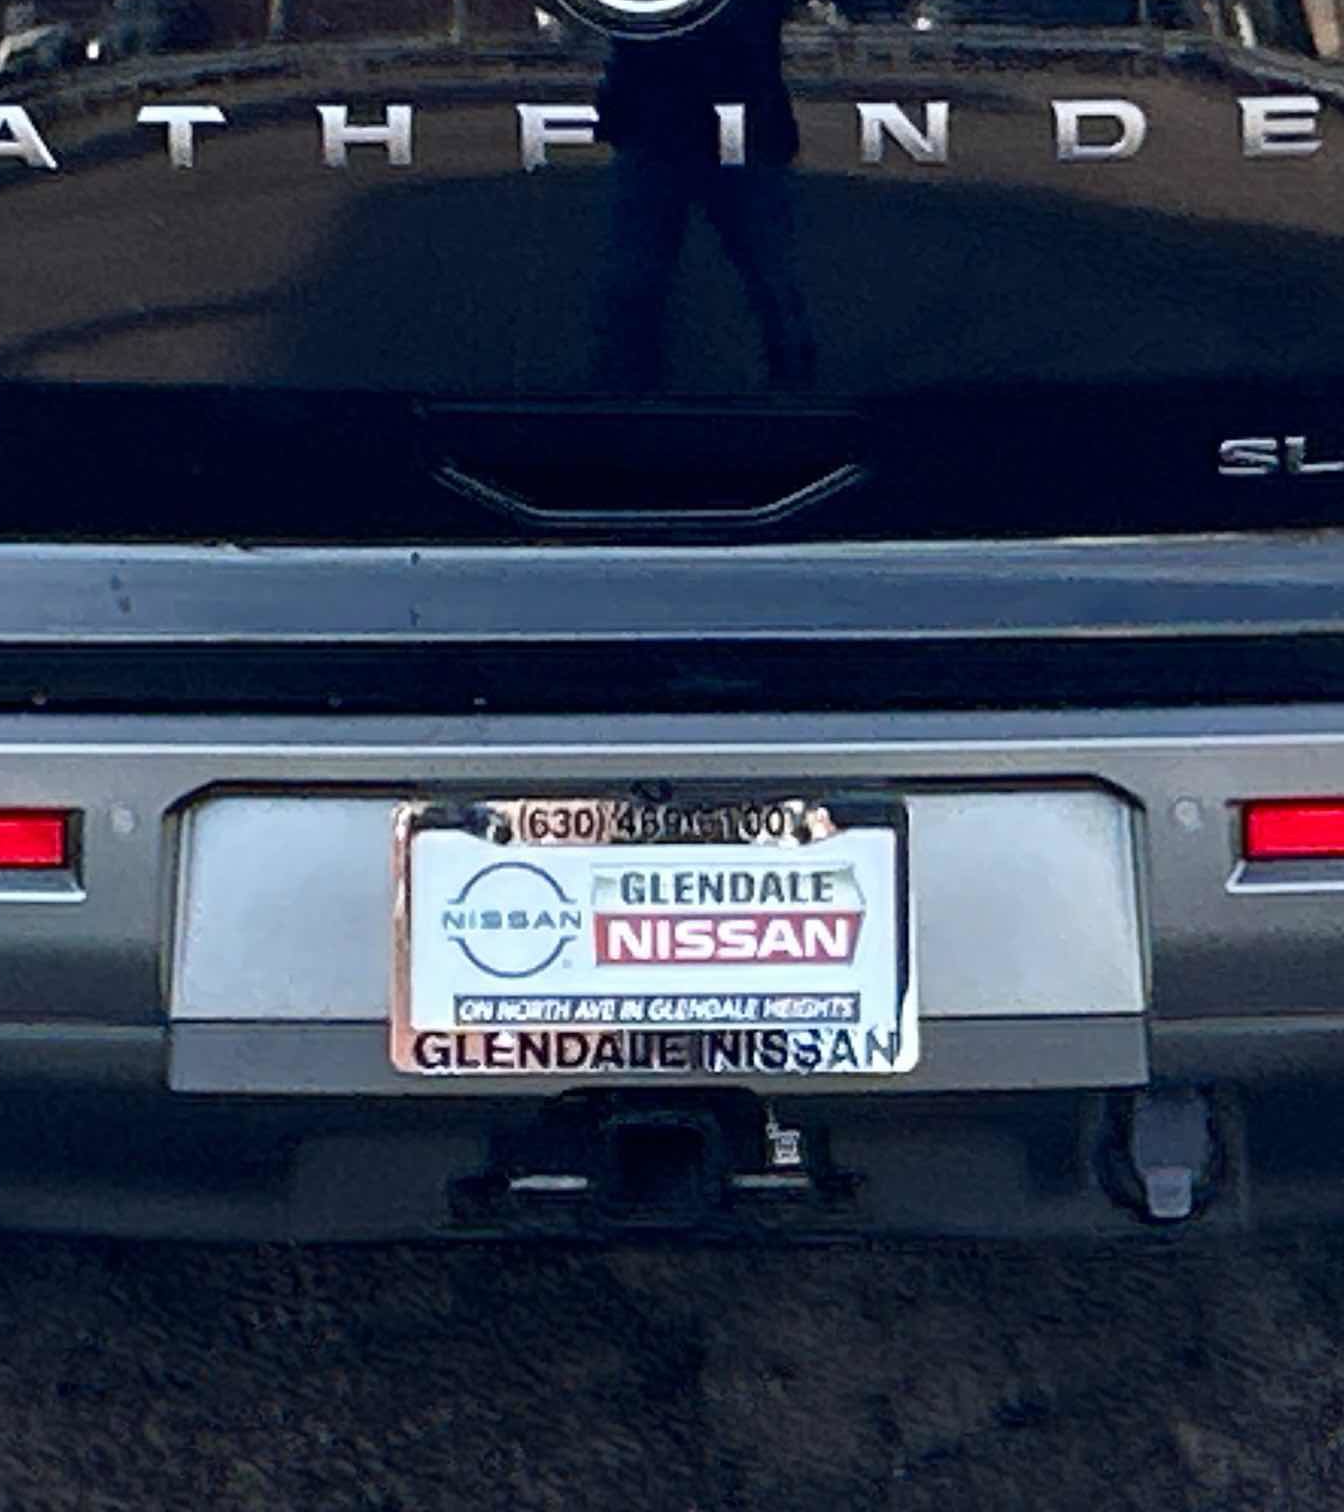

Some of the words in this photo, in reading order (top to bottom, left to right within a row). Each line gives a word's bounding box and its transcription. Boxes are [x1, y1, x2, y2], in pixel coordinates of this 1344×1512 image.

[520, 805, 605, 841] (630)
[620, 872, 834, 904] GLENDALE
[441, 909, 582, 929] NISSAN
[607, 919, 851, 960] NISSAN
[459, 999, 494, 1021] ON
[413, 1031, 688, 1070] GLENDALE
[706, 1029, 898, 1070] NISSAN
